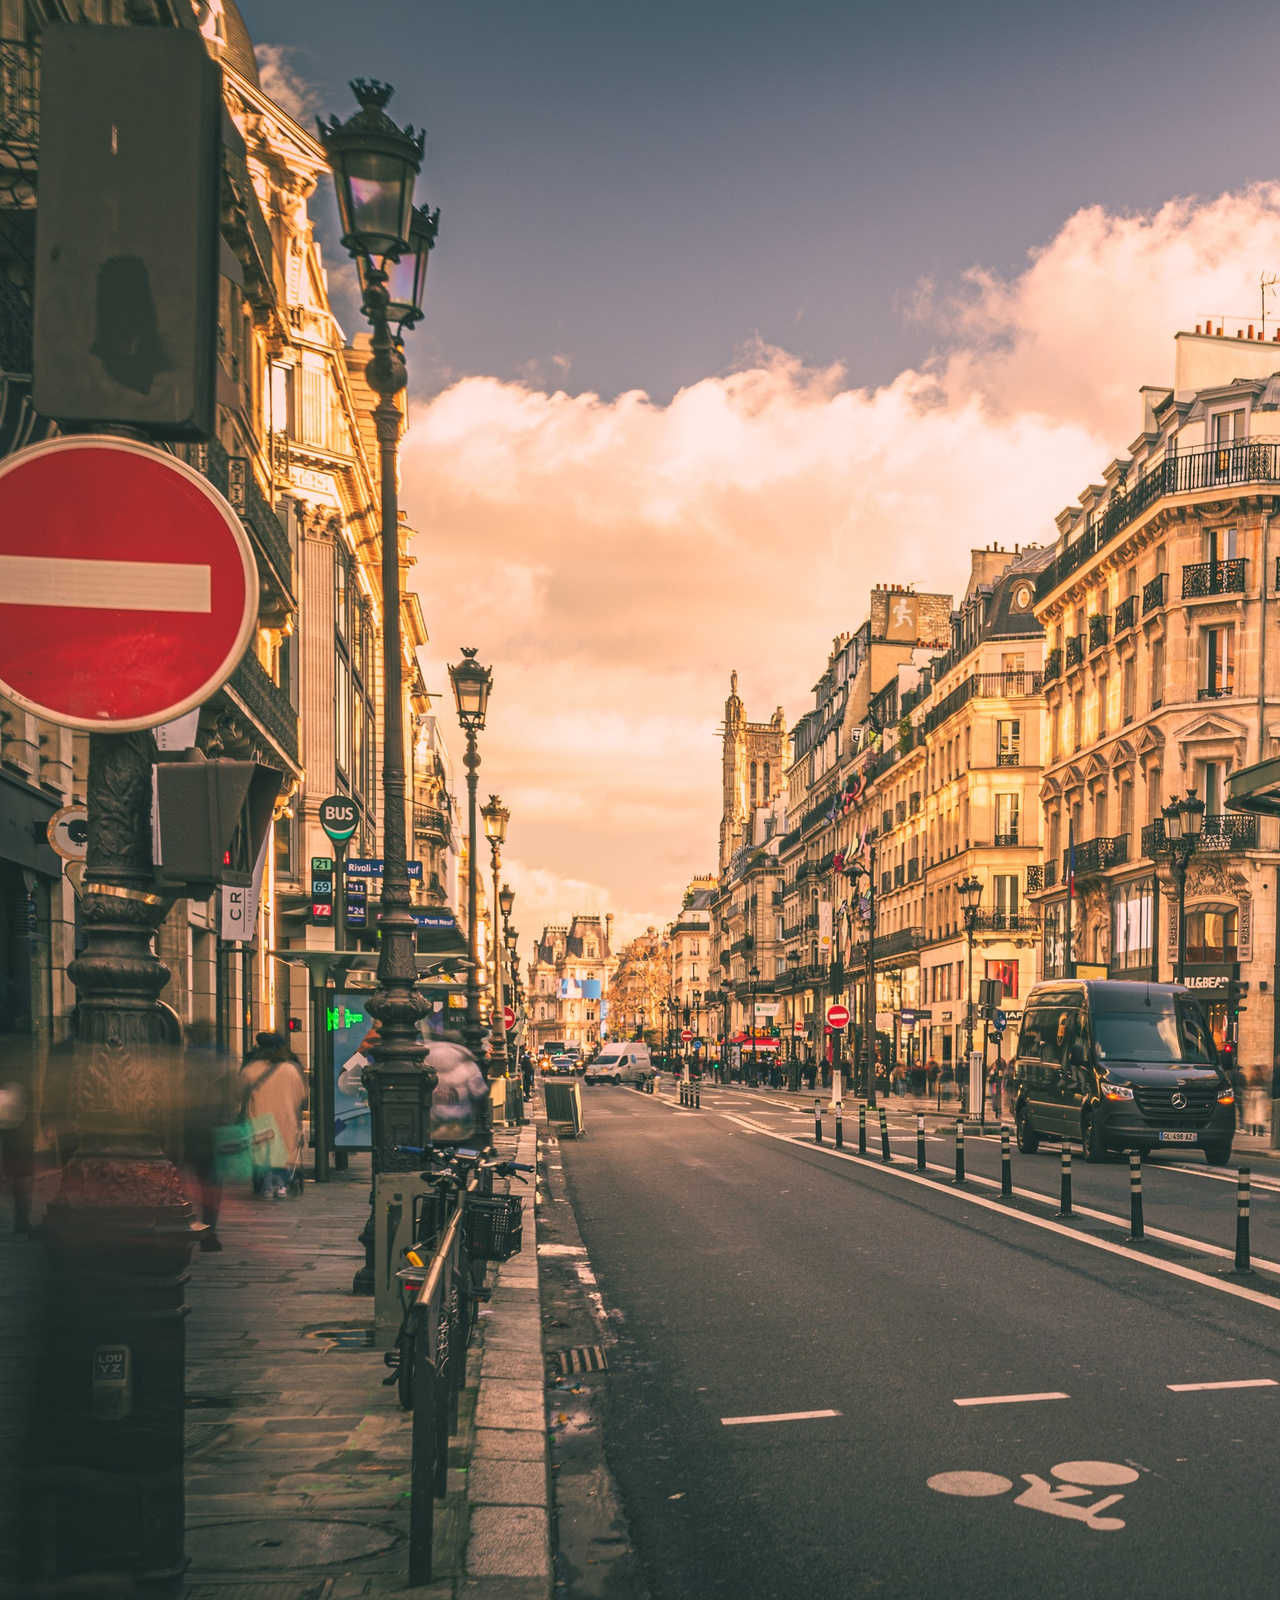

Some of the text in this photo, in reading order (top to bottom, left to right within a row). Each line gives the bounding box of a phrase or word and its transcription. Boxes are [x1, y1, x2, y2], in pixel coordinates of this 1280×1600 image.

[325, 806, 354, 821] BUS
[316, 860, 328, 869] 21
[348, 863, 371, 872] Rivoli
[315, 882, 329, 892] 69
[315, 904, 329, 915] 72
[424, 918, 438, 926] Pont
[98, 1354, 122, 1363] LOU
